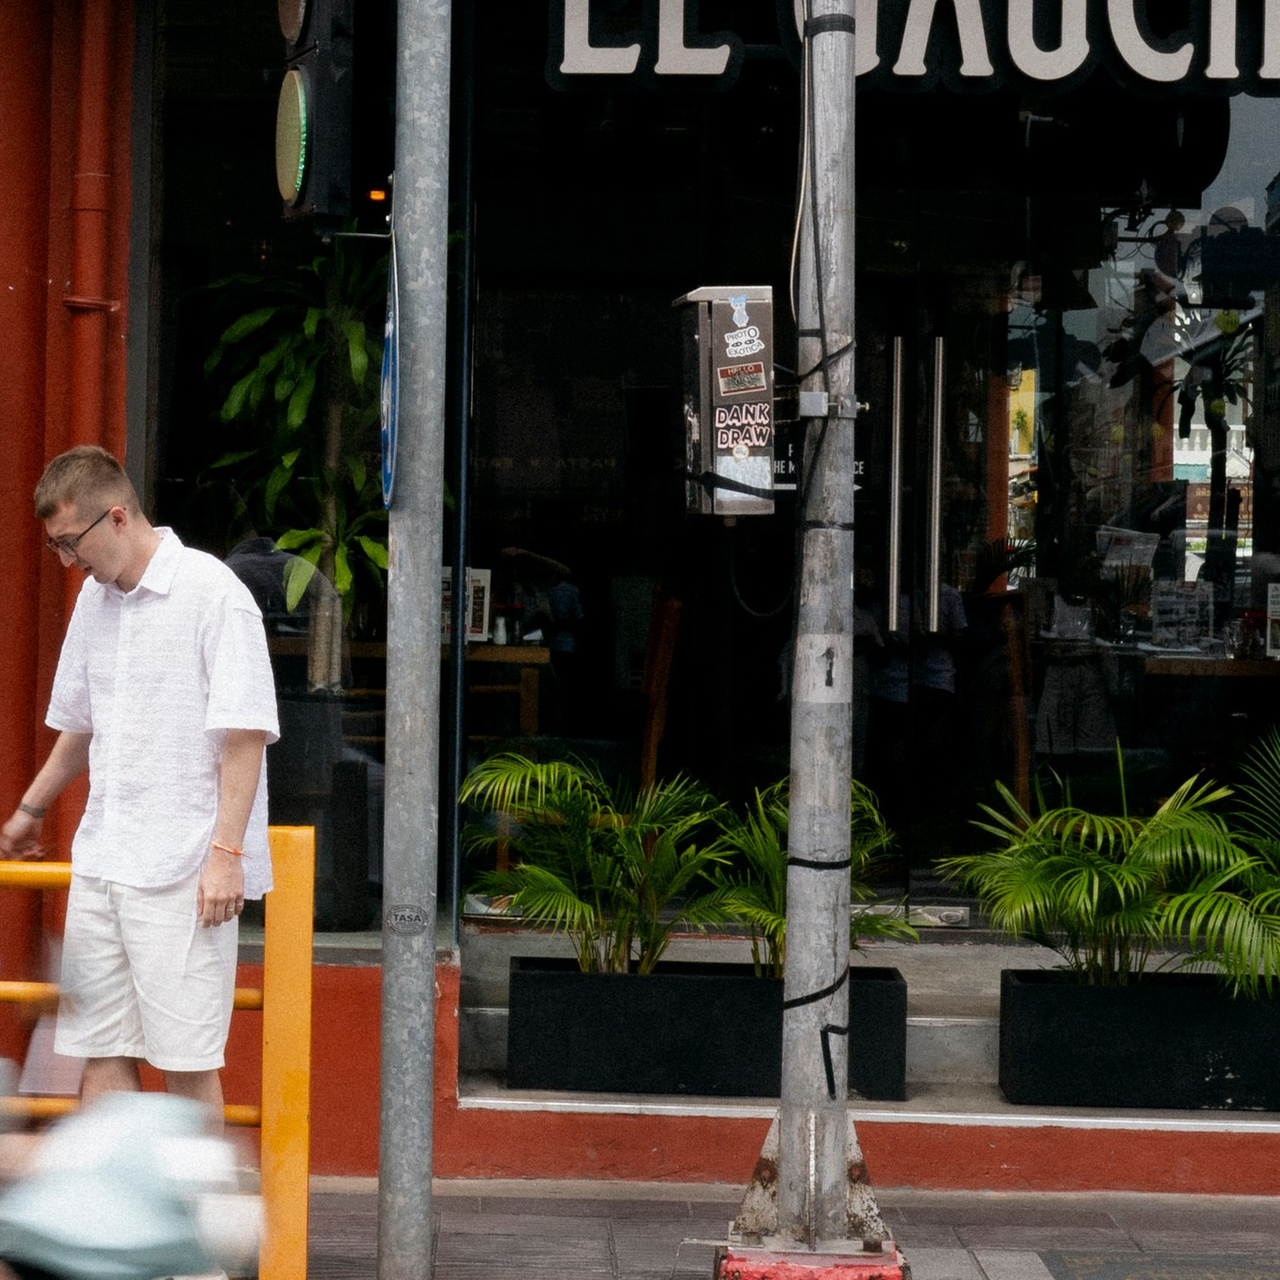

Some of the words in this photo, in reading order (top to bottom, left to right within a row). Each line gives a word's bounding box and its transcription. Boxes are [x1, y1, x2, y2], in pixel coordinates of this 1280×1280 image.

[726, 327, 758, 341] PROTO
[728, 341, 763, 356] EXOTICA
[716, 403, 770, 428] DANK
[717, 425, 771, 449] DRAW
